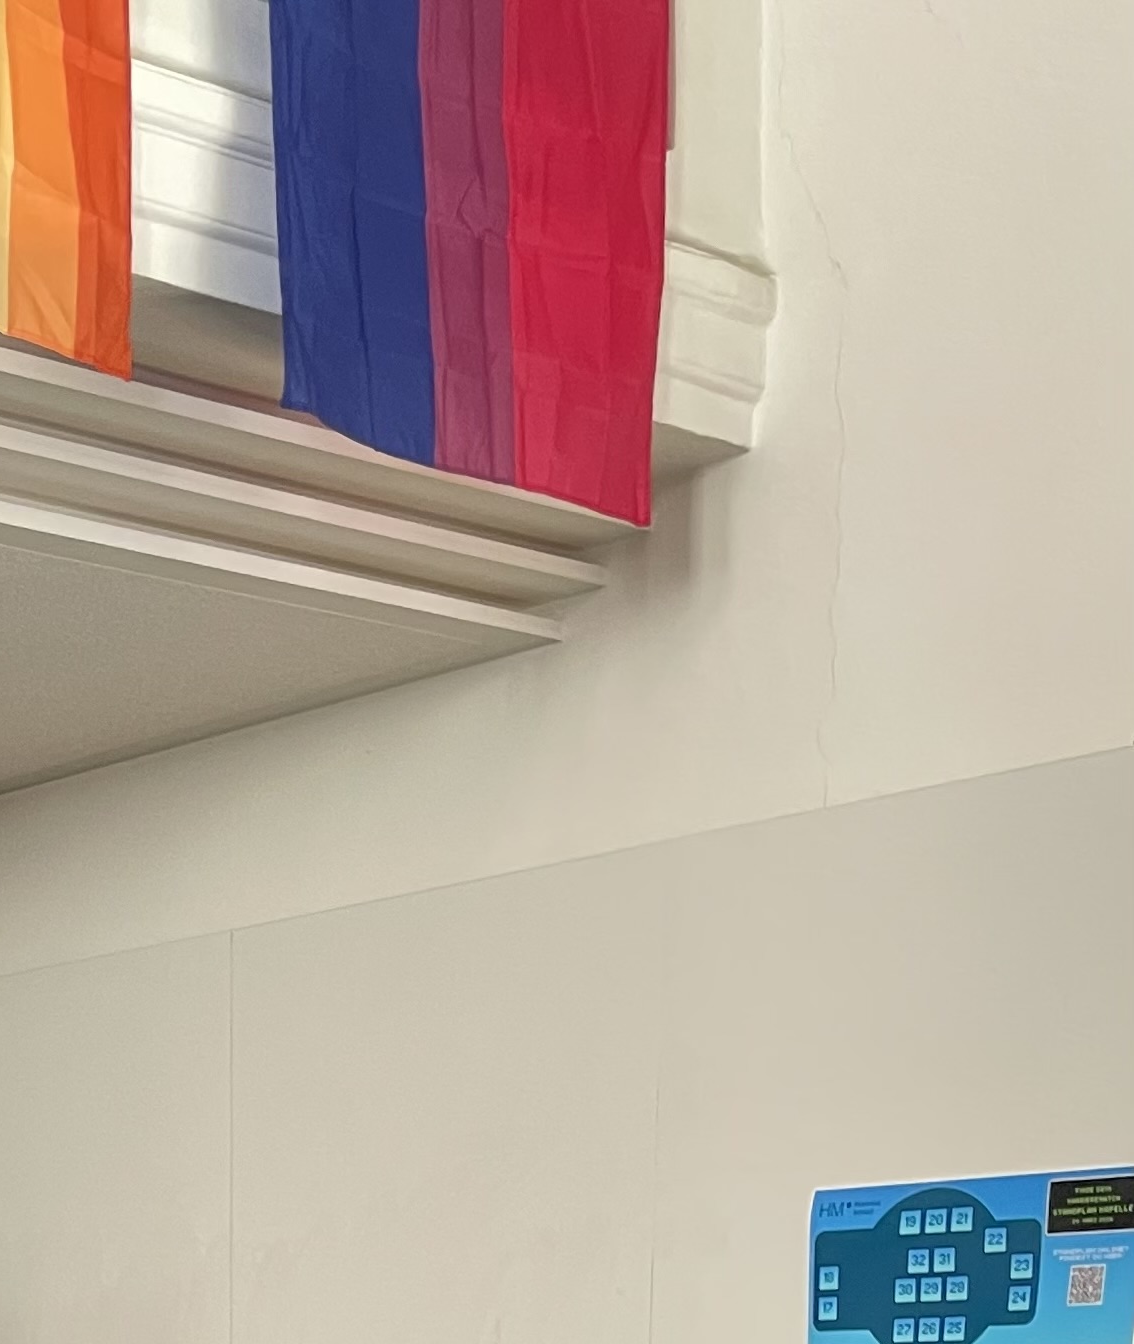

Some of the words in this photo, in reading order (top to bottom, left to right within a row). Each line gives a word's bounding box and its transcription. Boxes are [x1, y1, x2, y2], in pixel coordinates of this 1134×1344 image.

[819, 1201, 844, 1218] HM
[928, 1213, 944, 1226] 20
[956, 1212, 968, 1225] 21
[987, 1233, 1003, 1245] 22
[910, 1254, 926, 1266] 32
[938, 1253, 950, 1265] 31
[1013, 1259, 1029, 1271] 23
[898, 1283, 913, 1296] 30
[1011, 1291, 1027, 1304] 24
[896, 1323, 912, 1336] 27
[921, 1322, 937, 1335] 26
[946, 1321, 962, 1334] 25
